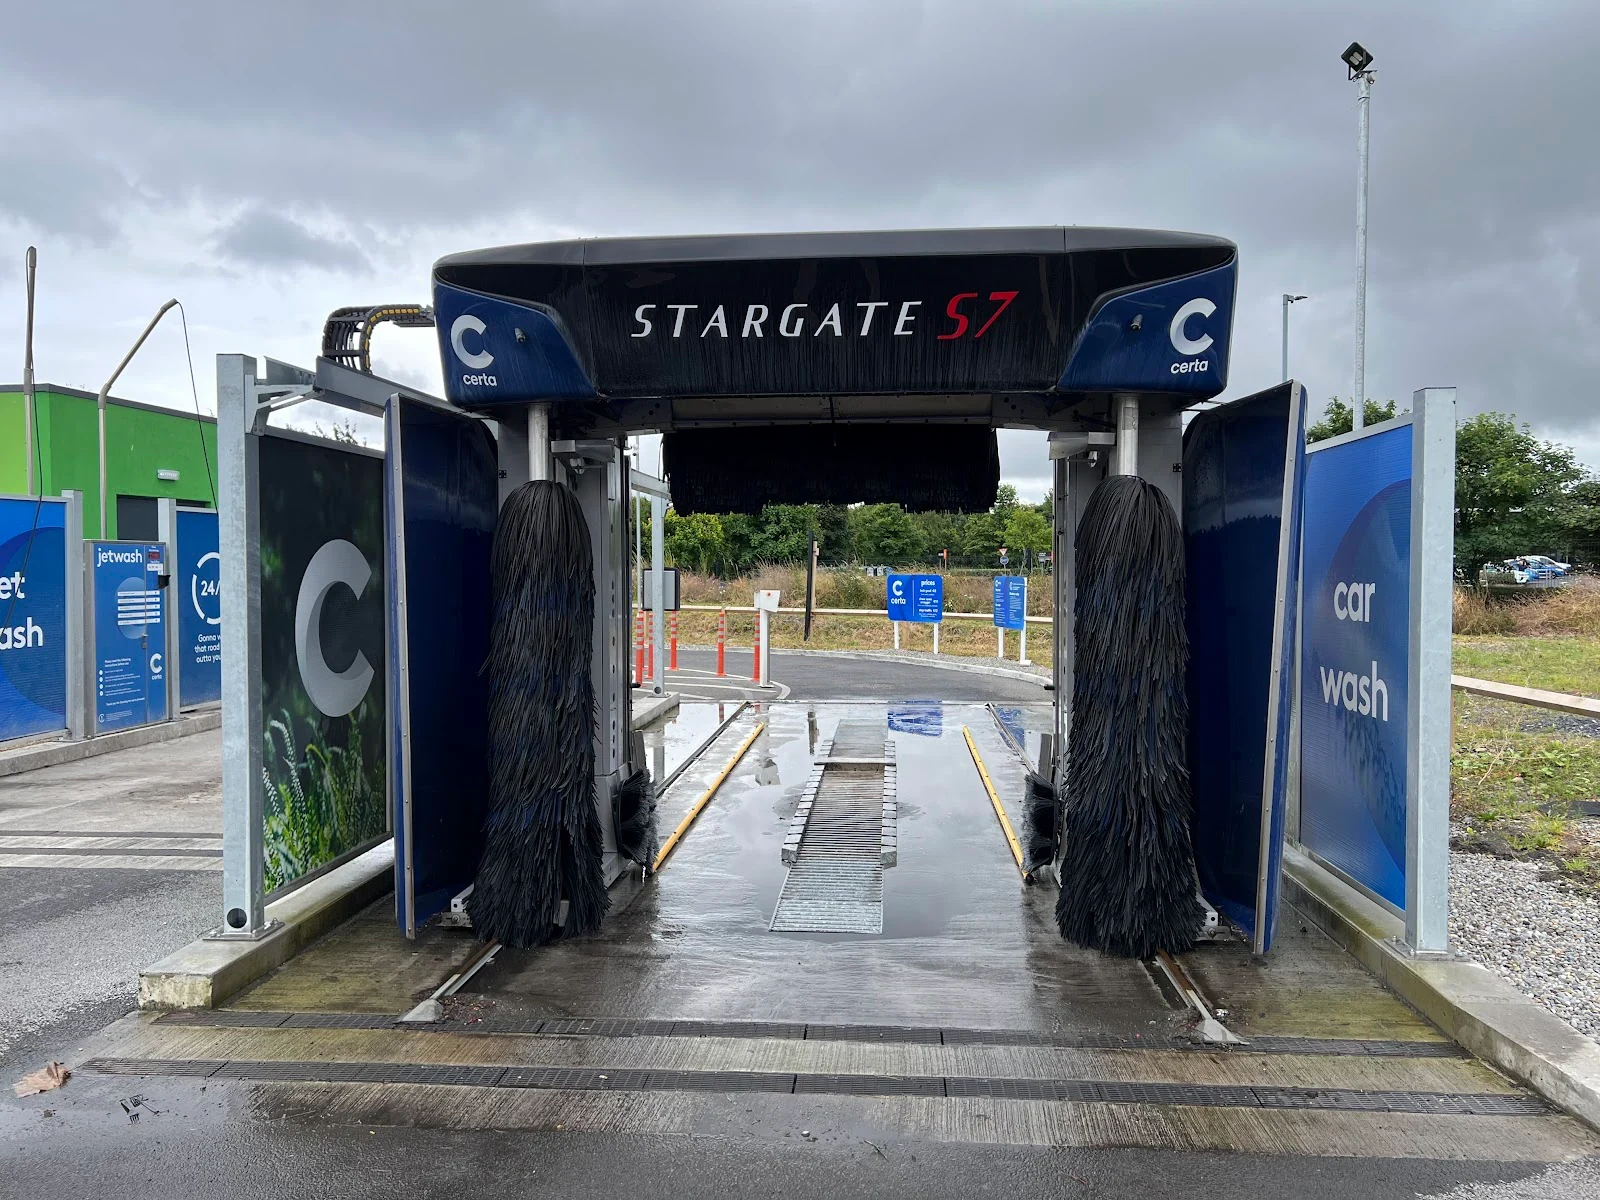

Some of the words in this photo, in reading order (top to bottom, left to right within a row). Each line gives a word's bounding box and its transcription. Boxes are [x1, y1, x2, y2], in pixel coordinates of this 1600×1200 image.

[630, 301, 923, 339] STARGATE
[936, 291, 1020, 341] S7
[1170, 358, 1209, 375] certa
[462, 372, 498, 388] certa
[96, 547, 143, 568] jetwash
[921, 579, 936, 587] prices
[890, 596, 907, 605] certa
[1333, 581, 1376, 623] car
[198, 634, 216, 642] Gonna
[195, 643, 206, 653] that
[208, 641, 219, 651] road
[196, 655, 211, 663] outta
[1319, 660, 1389, 722] wash
